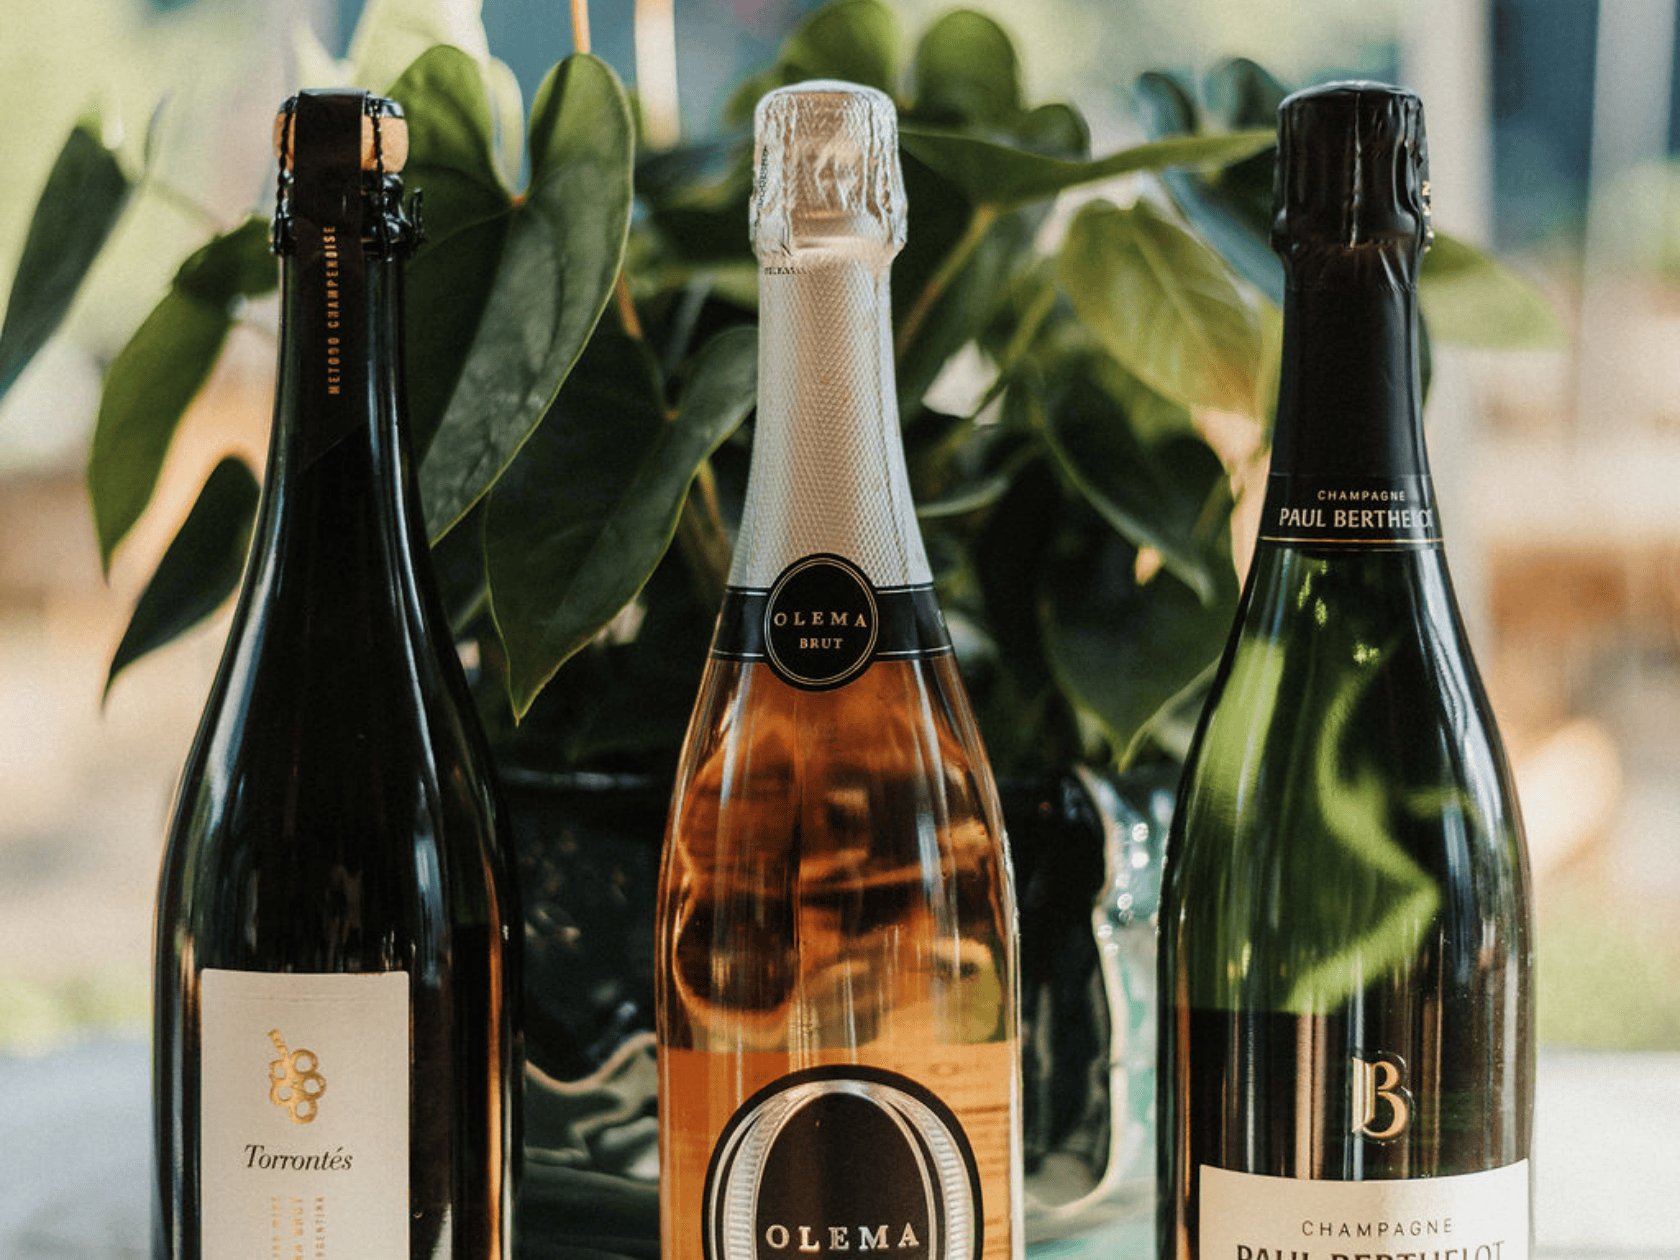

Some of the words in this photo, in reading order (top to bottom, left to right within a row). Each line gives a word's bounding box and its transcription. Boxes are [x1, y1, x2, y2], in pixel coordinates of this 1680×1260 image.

[323, 225, 341, 329] CHAMPENOISE
[327, 337, 341, 395] METODO
[1317, 490, 1406, 501] CHAMPAGNE
[1279, 507, 1327, 528] PAUL
[773, 611, 868, 628] OLEMA
[799, 637, 844, 650] BRUT
[244, 1144, 354, 1171] Torrontés
[314, 1196, 325, 1260] RGENTINA
[765, 1222, 919, 1251] OLEMA
[1301, 1217, 1453, 1238] CHAMPAGNE
